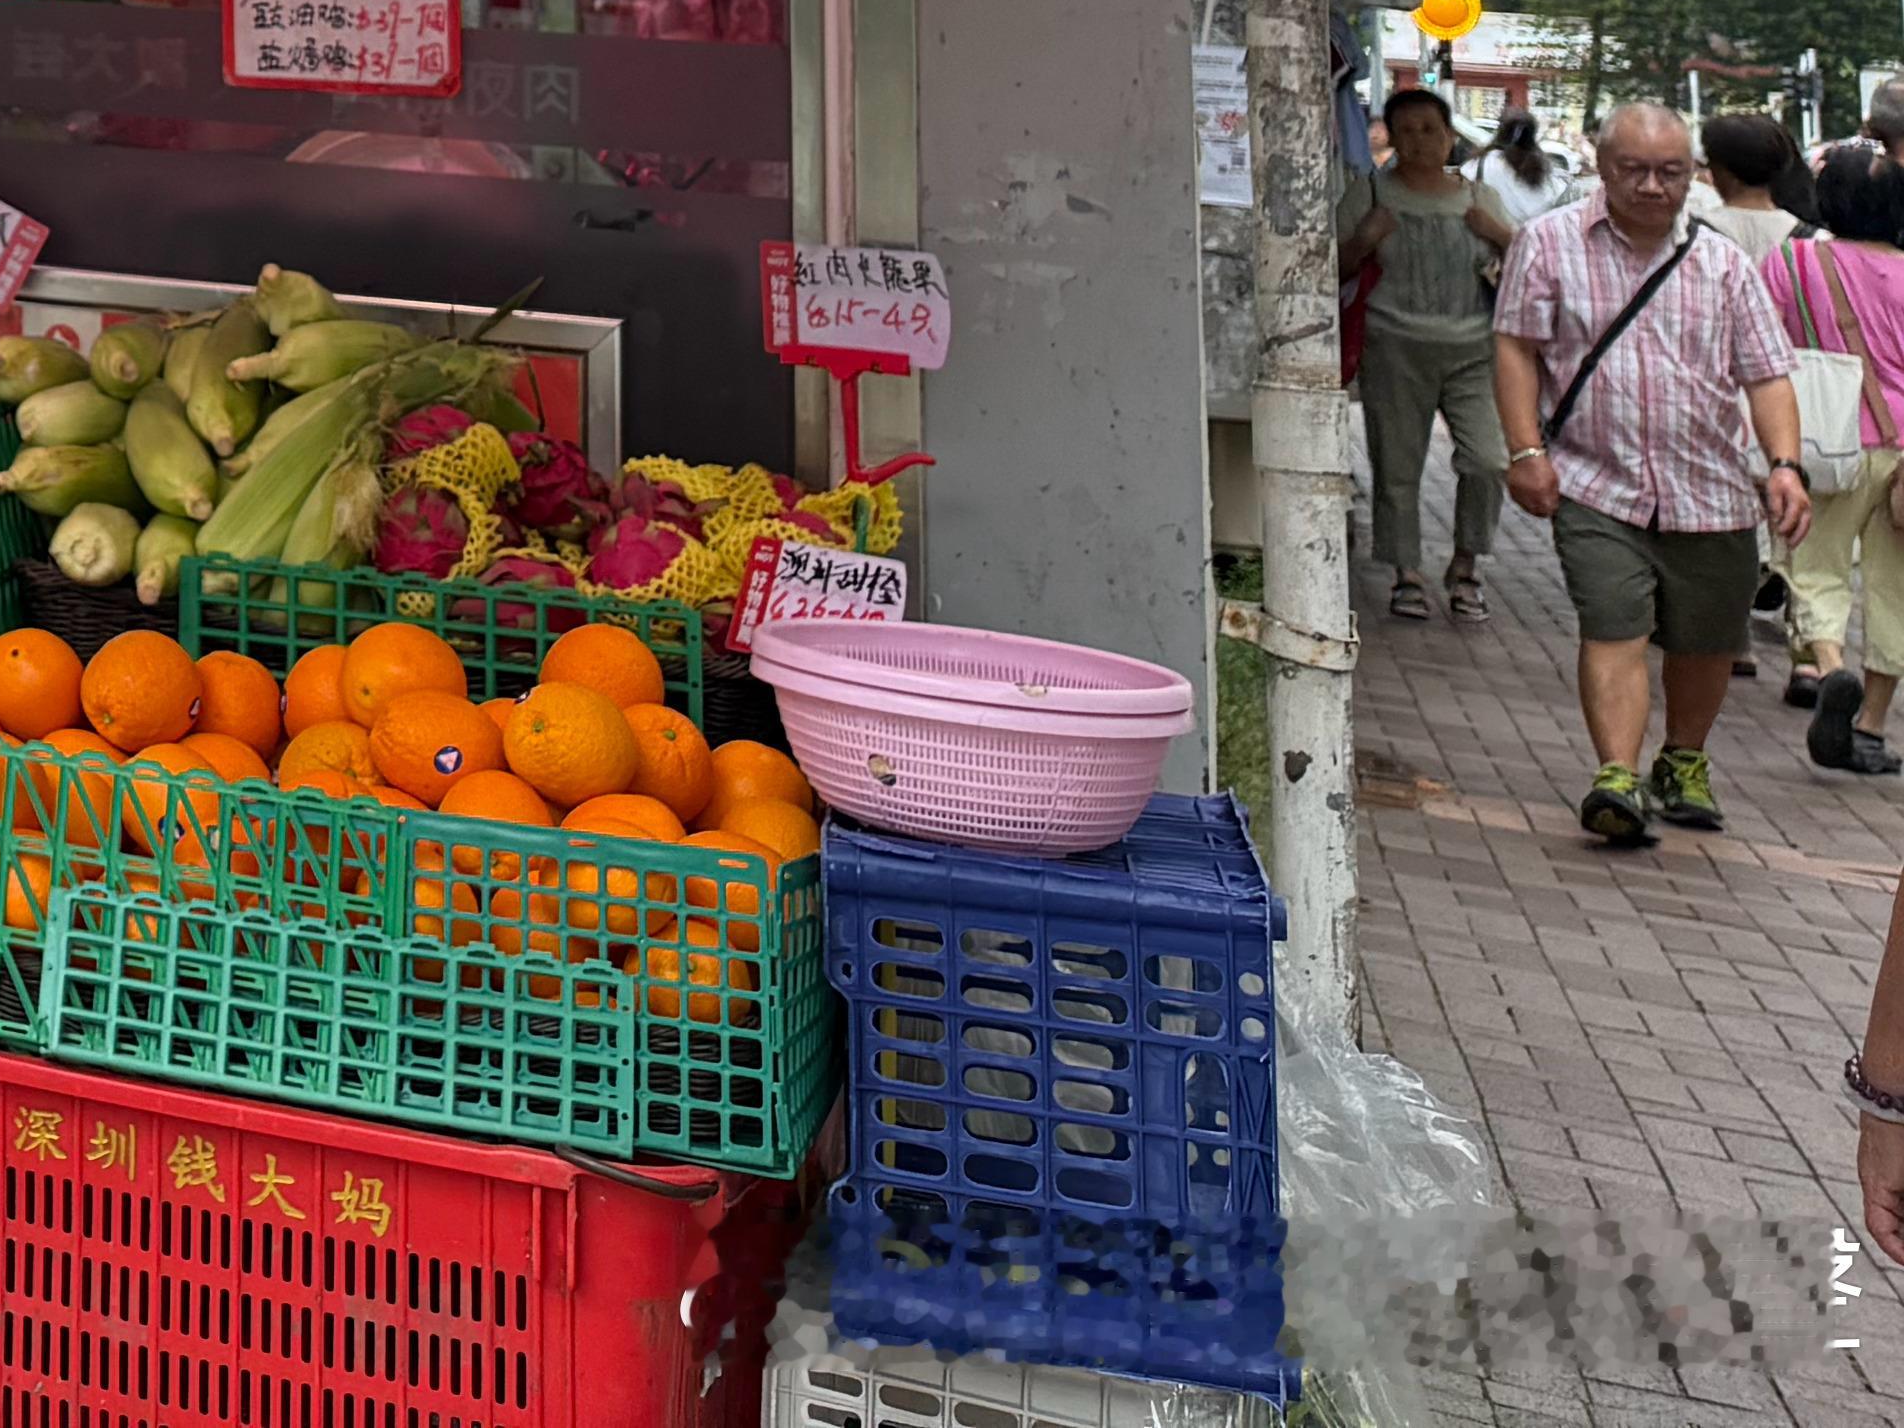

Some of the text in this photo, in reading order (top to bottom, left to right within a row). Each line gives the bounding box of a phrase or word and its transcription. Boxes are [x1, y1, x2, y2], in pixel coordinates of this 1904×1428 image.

[13, 1102, 393, 1240] 深圳钱大妈
